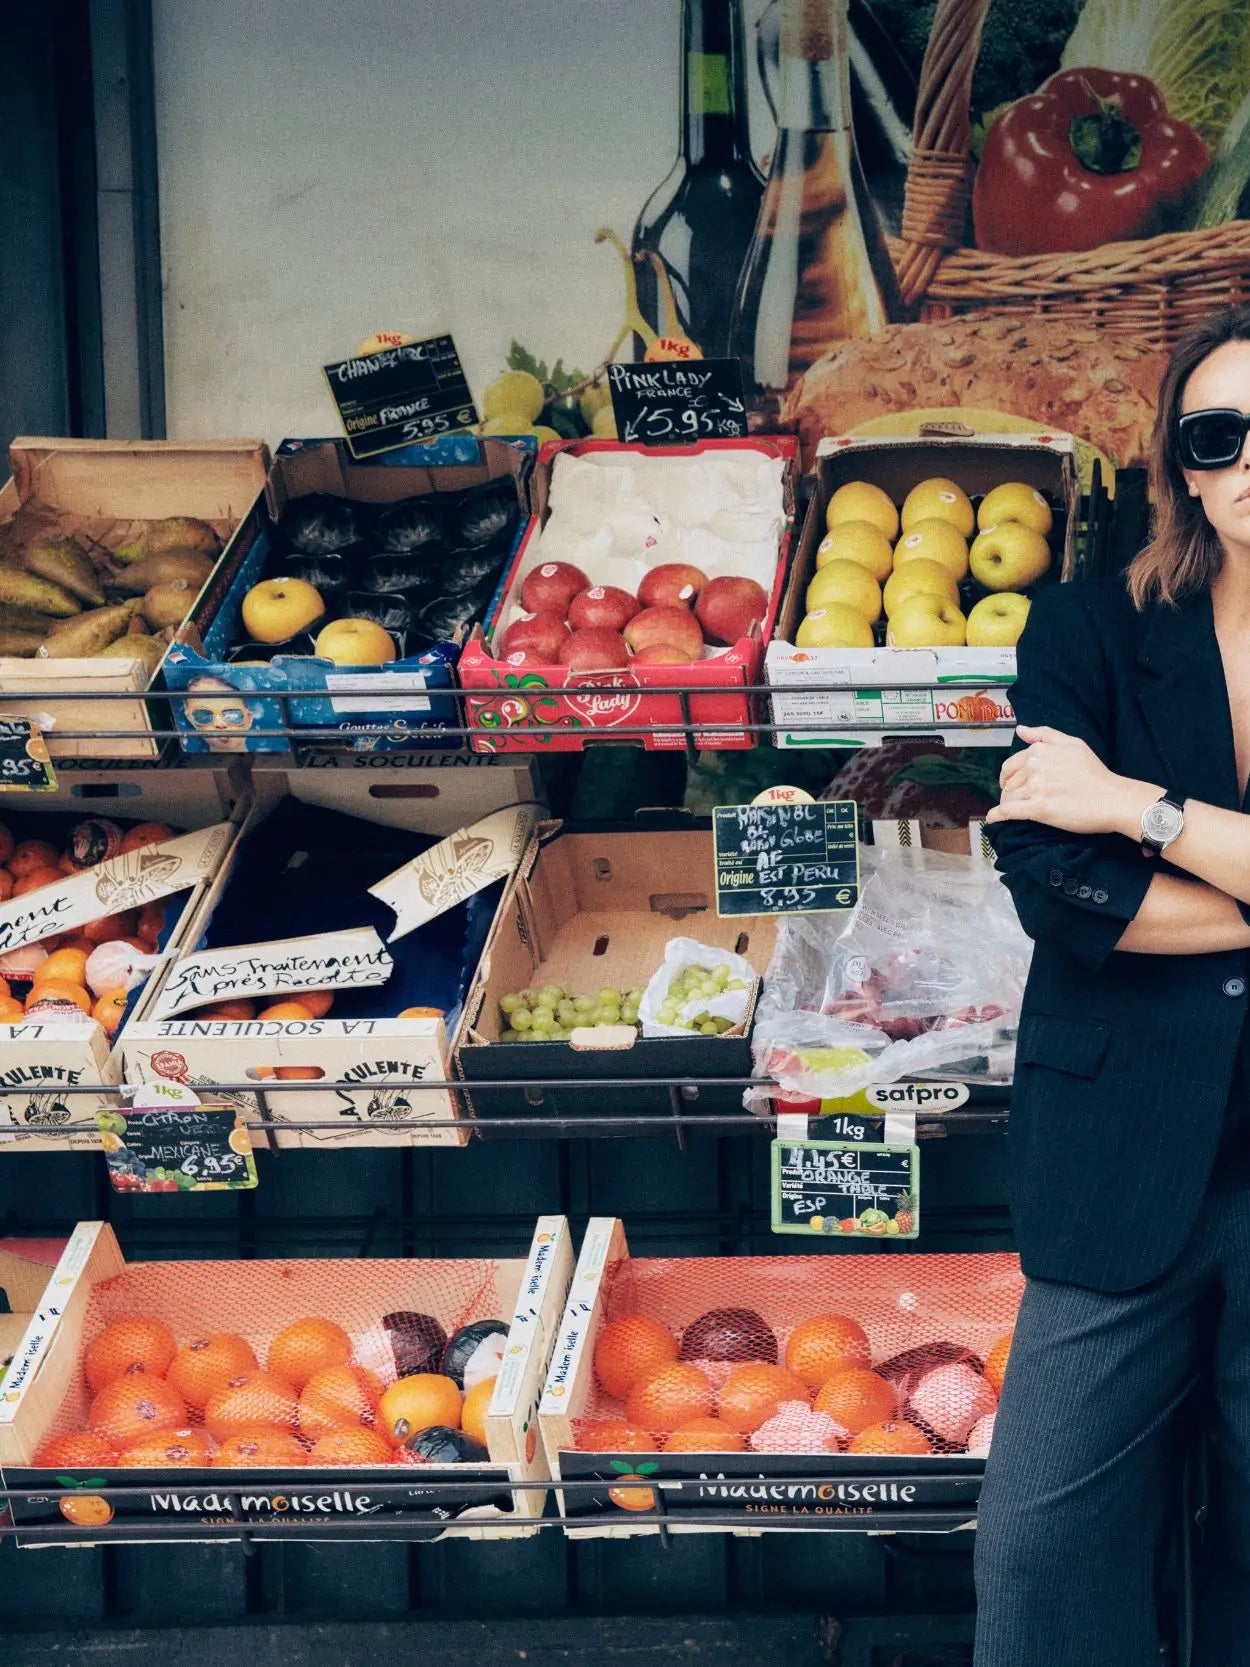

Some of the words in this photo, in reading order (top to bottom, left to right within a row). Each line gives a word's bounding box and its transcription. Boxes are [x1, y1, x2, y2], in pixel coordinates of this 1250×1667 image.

[376, 334, 402, 346] 1kg
[661, 339, 691, 358] 1kg
[663, 370, 712, 388] LADY
[636, 386, 692, 398] FRANCE
[346, 415, 378, 431] Origine
[456, 409, 472, 424] €
[586, 690, 631, 716] Lady
[306, 754, 339, 768] LA
[353, 754, 501, 768] SOCULENTE
[768, 789, 796, 802] 1kg
[719, 870, 755, 887] Origine
[791, 863, 839, 886] PERU
[835, 889, 851, 905] €
[165, 964, 237, 991] Sans
[10, 1025, 44, 1039] LA
[158, 1021, 325, 1037] SOCULENTE
[342, 1021, 377, 1035] LA
[153, 1084, 183, 1099] 1kg
[875, 1083, 959, 1105] safpro
[833, 1116, 865, 1140] 1kg
[840, 1152, 856, 1168] €
[801, 1170, 871, 1184] ORANGE
[793, 1197, 827, 1215] ESP
[745, 1504, 787, 1513] SIGNE
[792, 1505, 810, 1514] LA
